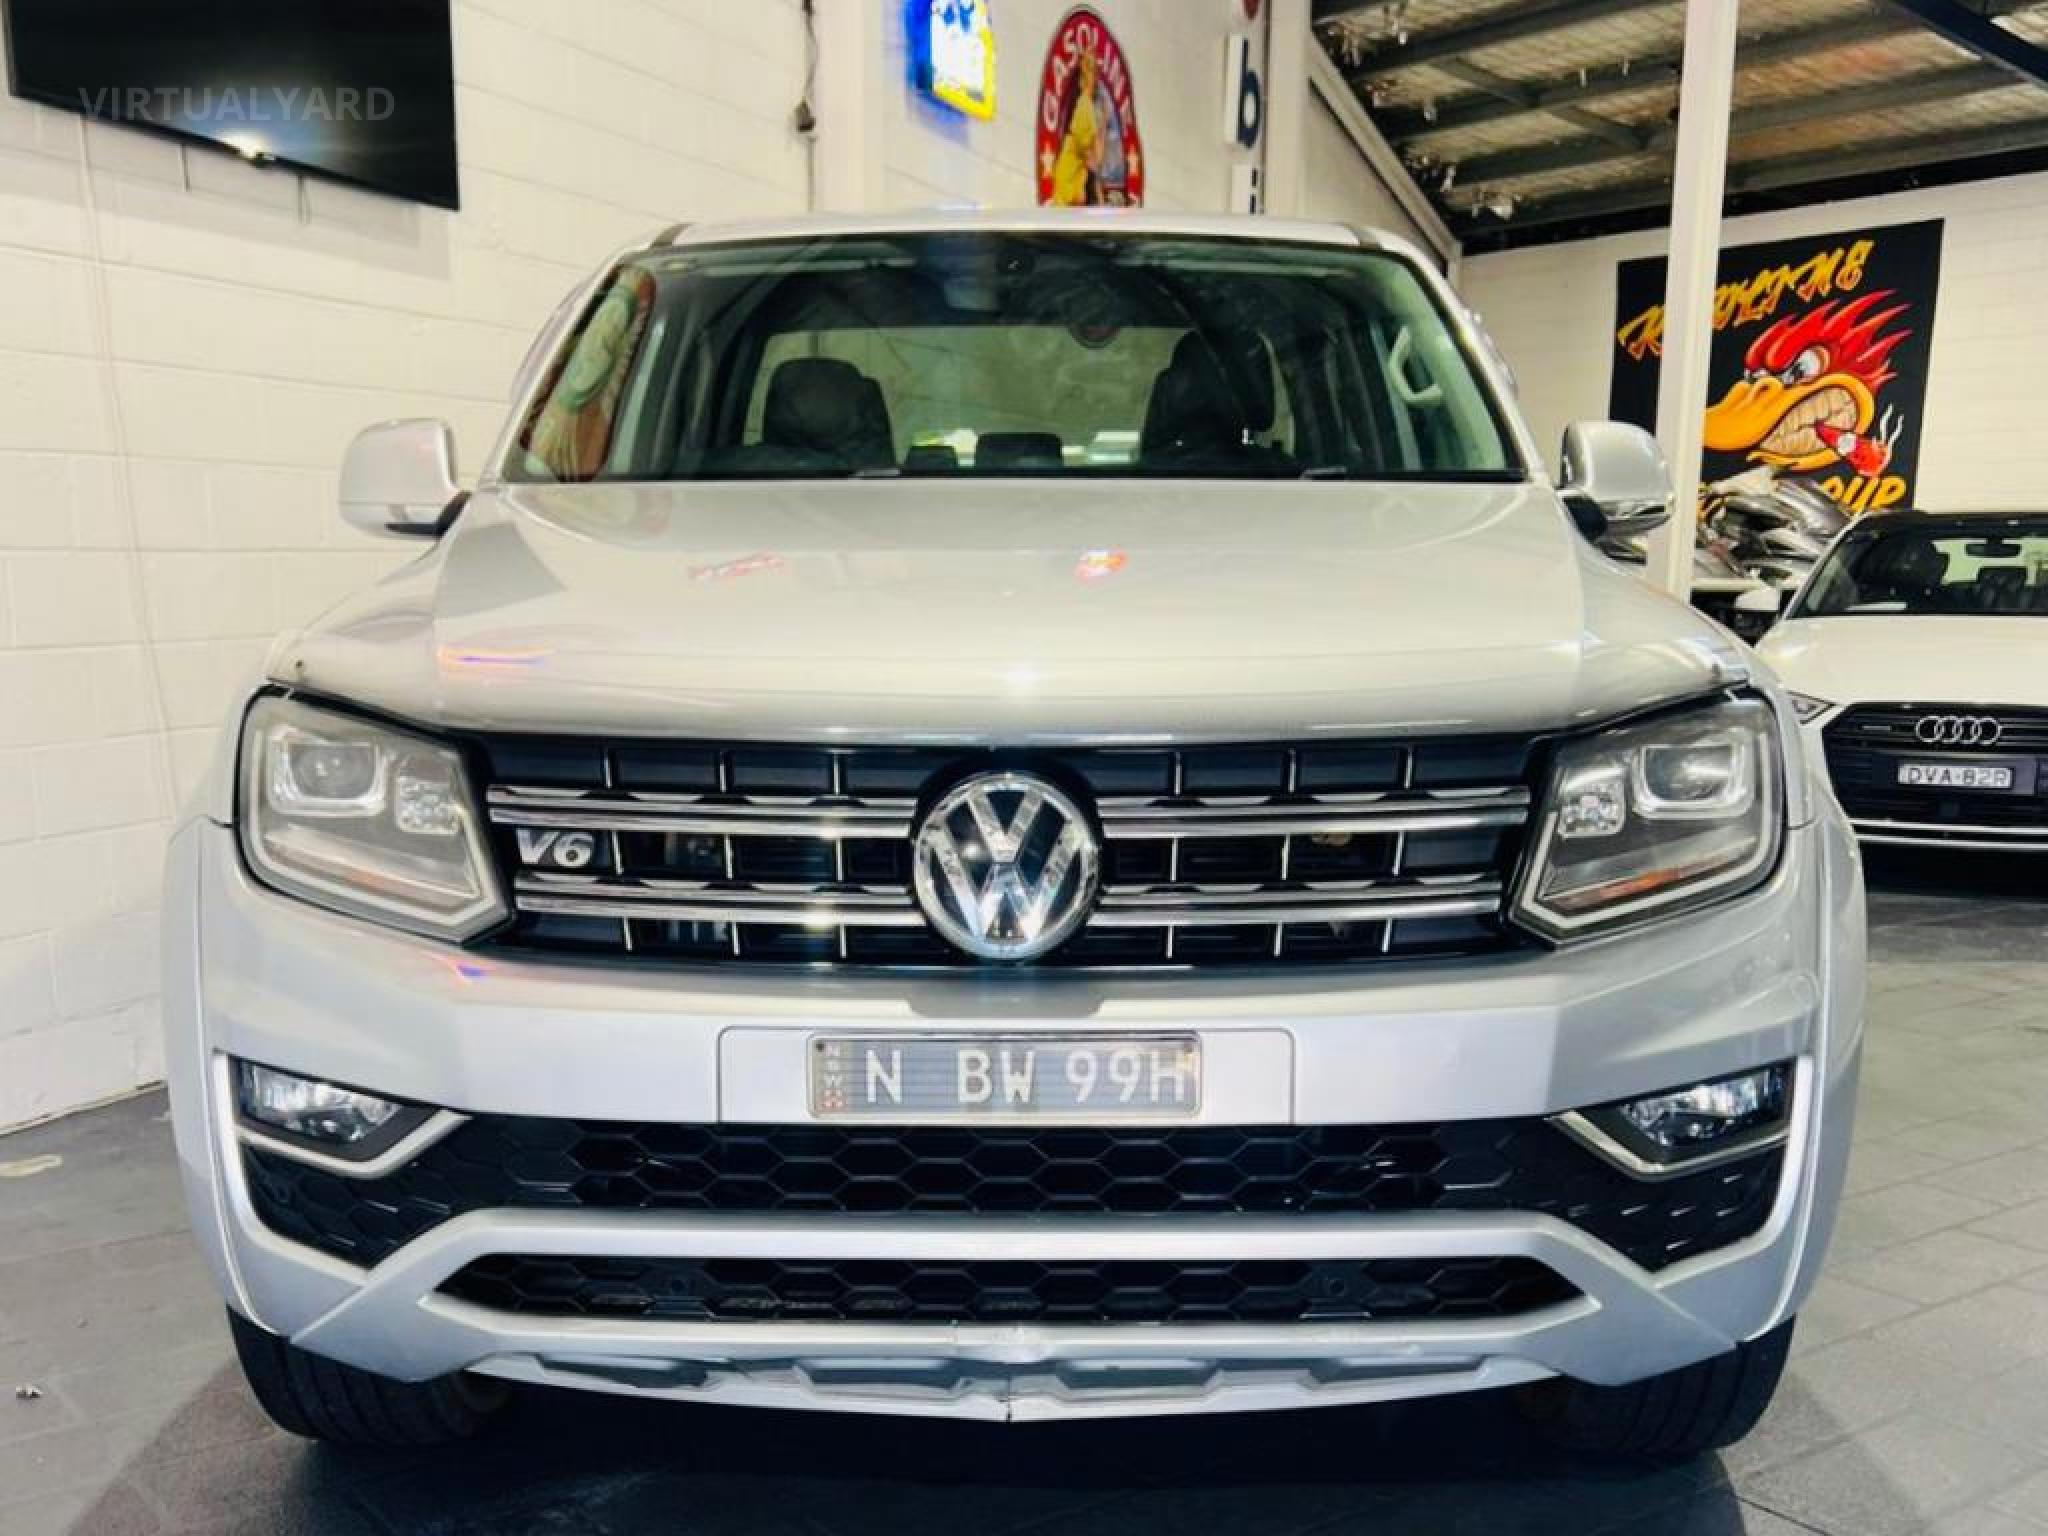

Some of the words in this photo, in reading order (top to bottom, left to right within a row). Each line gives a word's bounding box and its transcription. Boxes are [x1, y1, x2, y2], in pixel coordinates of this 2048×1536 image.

[517, 829, 594, 868] V6
[866, 1049, 902, 1103] N
[958, 1050, 1036, 1103] BW
[1066, 1049, 1184, 1103] 99H
